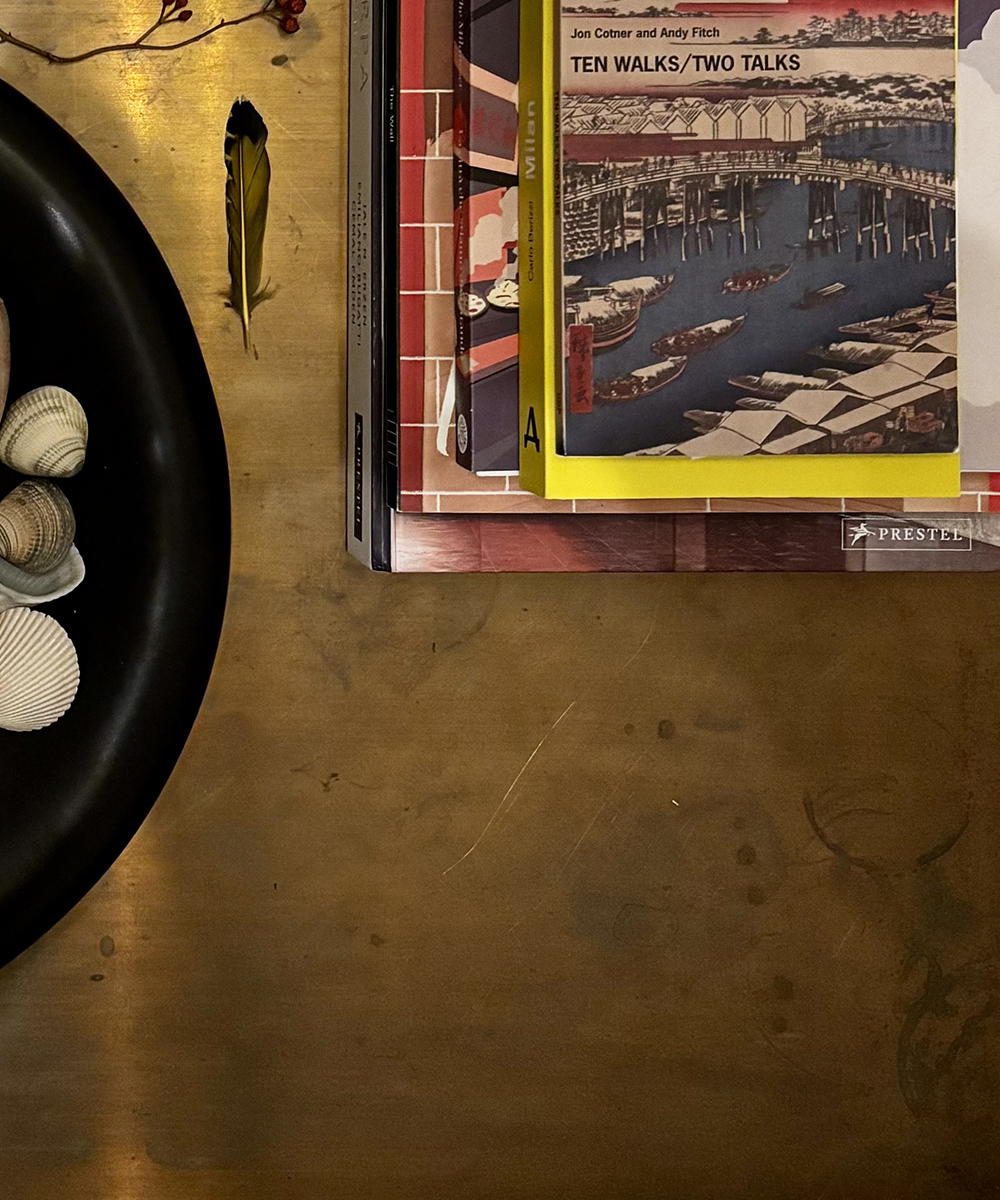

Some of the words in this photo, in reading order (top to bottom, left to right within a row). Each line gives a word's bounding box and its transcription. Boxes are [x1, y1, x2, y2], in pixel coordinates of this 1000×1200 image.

[571, 28, 591, 39] Jon
[595, 28, 632, 39] Cotner
[636, 28, 657, 39] and
[660, 27, 689, 41] Andy
[692, 26, 720, 38] Fitch
[570, 56, 608, 73] TEN
[614, 53, 735, 74] WALKS/TWO
[741, 54, 801, 71] TALKS
[525, 100, 536, 180] Milan
[878, 527, 963, 541] PRESTEL
